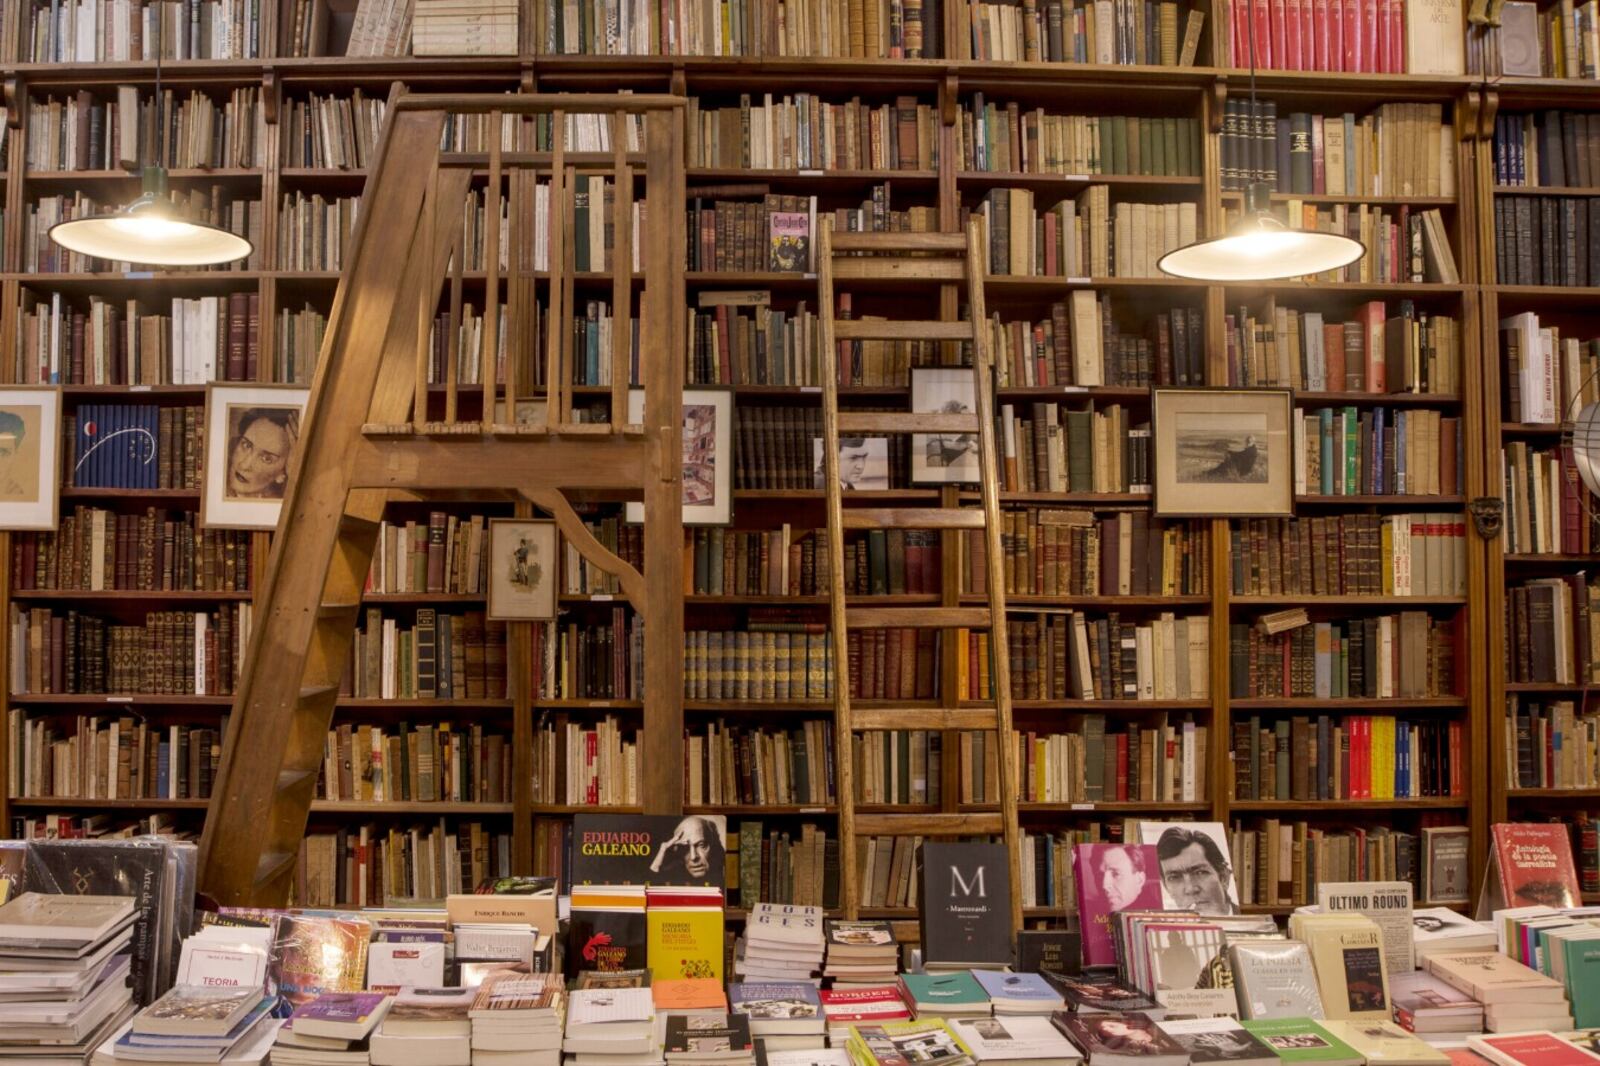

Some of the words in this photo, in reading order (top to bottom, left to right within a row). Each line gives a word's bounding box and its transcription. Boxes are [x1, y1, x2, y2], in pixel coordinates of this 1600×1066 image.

[582, 832, 650, 844] EDUARDO
[582, 843, 650, 856] GALEANO
[143, 867, 155, 890] Arte
[950, 865, 987, 898] M
[143, 891, 153, 904] de
[1329, 895, 1369, 910] ULTIMO
[1372, 895, 1408, 909] ROUND
[203, 976, 239, 986] TEORIA
